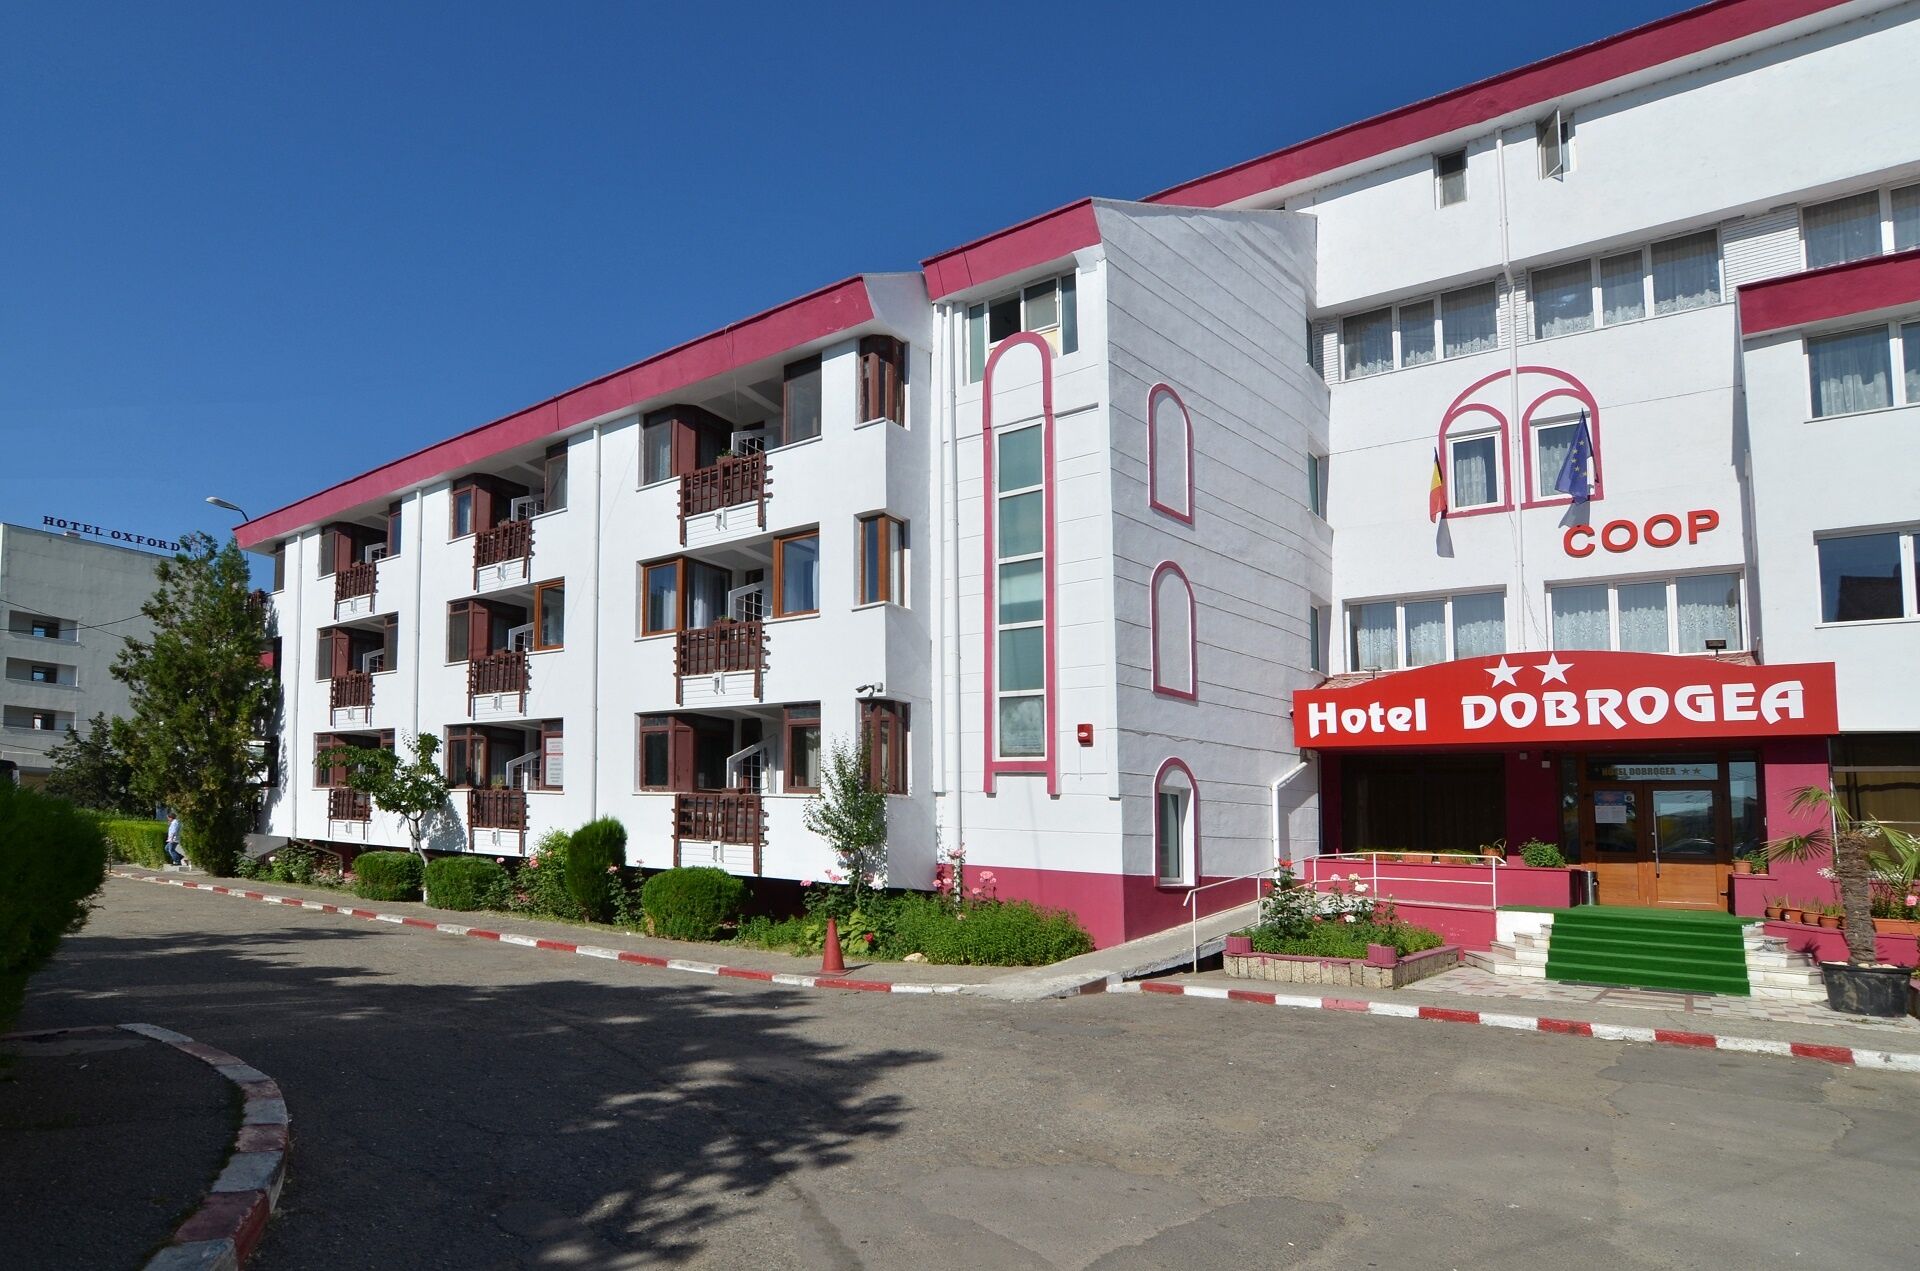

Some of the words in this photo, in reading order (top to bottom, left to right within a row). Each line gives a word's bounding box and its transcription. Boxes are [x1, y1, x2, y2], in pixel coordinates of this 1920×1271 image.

[43, 516, 103, 536] HOTEL
[111, 531, 181, 552] OXFORD
[1563, 509, 1720, 558] COOP
[1308, 698, 1427, 739] Hotel
[1461, 680, 1806, 730] DOBROGEA
